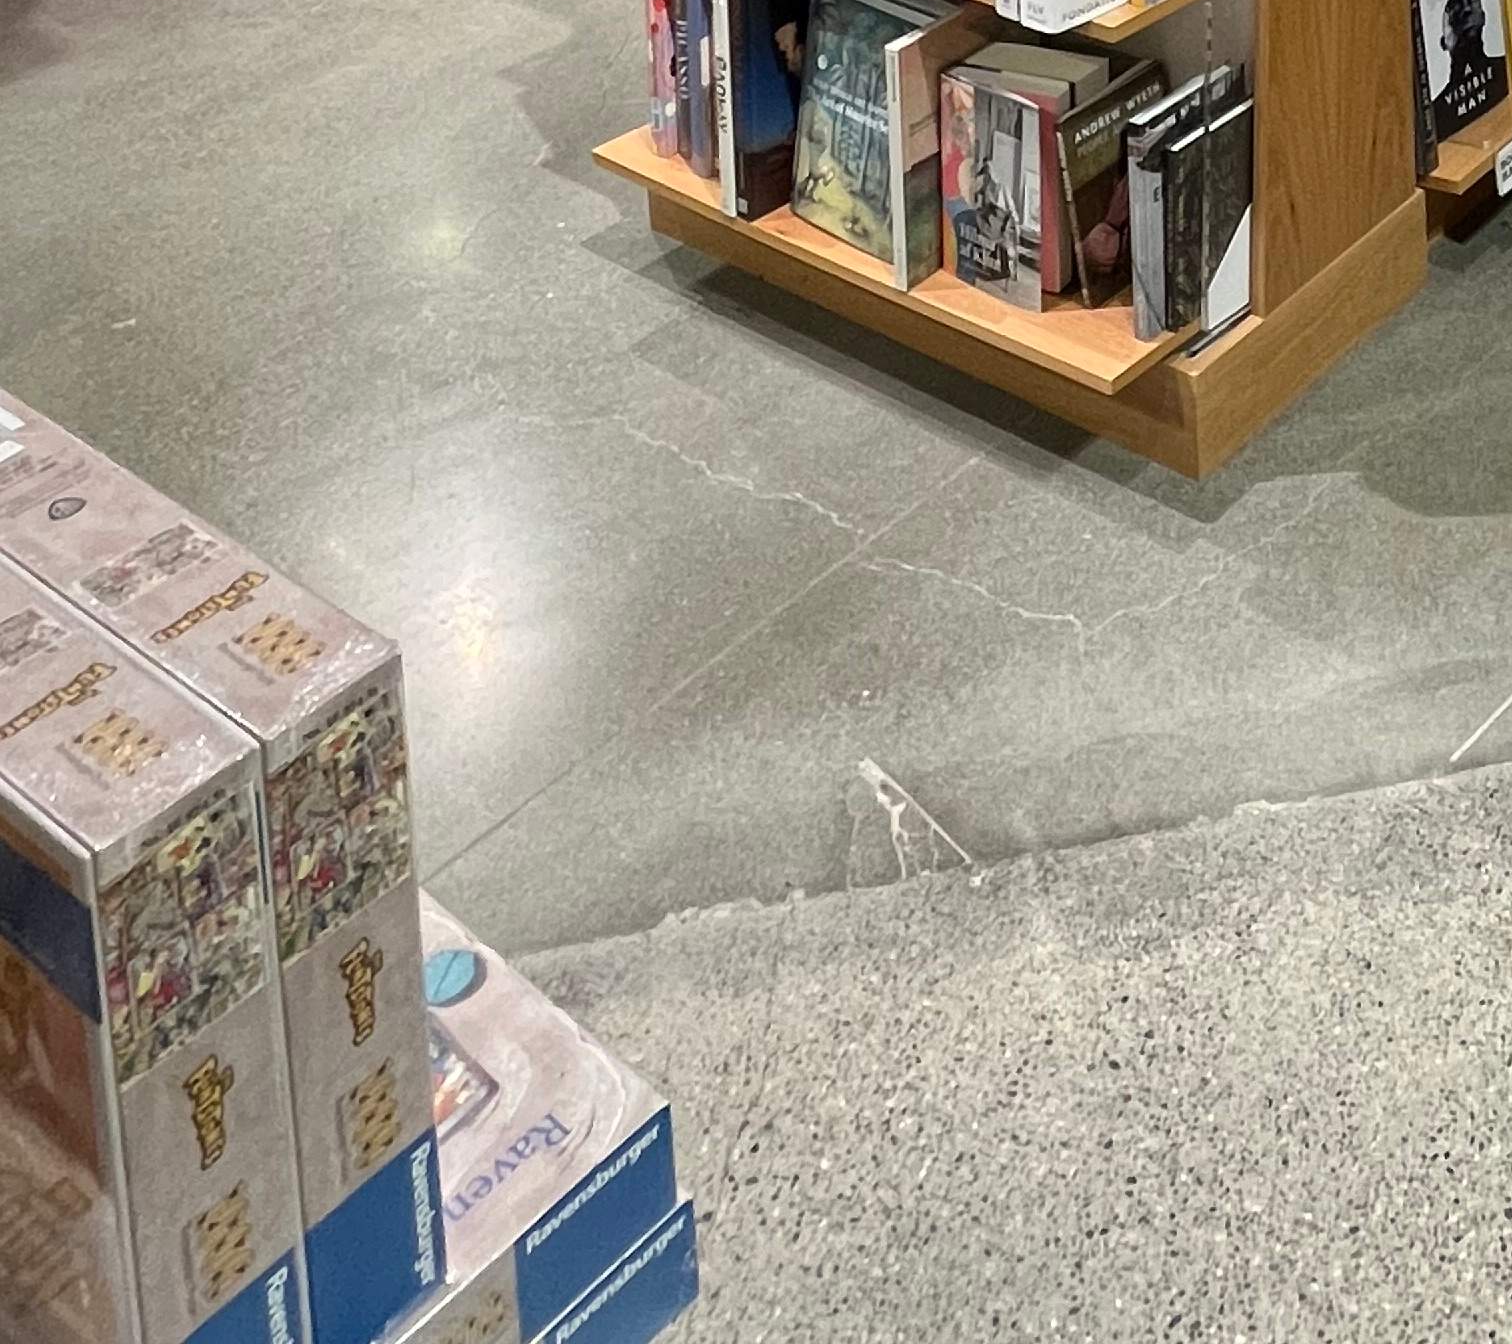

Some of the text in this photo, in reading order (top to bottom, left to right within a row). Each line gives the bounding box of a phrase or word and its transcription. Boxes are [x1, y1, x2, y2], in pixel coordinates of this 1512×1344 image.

[1444, 66, 1494, 106] VISIBLE
[1457, 91, 1488, 118] MAN
[1073, 105, 1121, 145] ANDREW
[525, 1124, 661, 1256] Ravensburger
[264, 1265, 296, 1344] Ravens
[554, 1215, 686, 1344] Ravensburger
